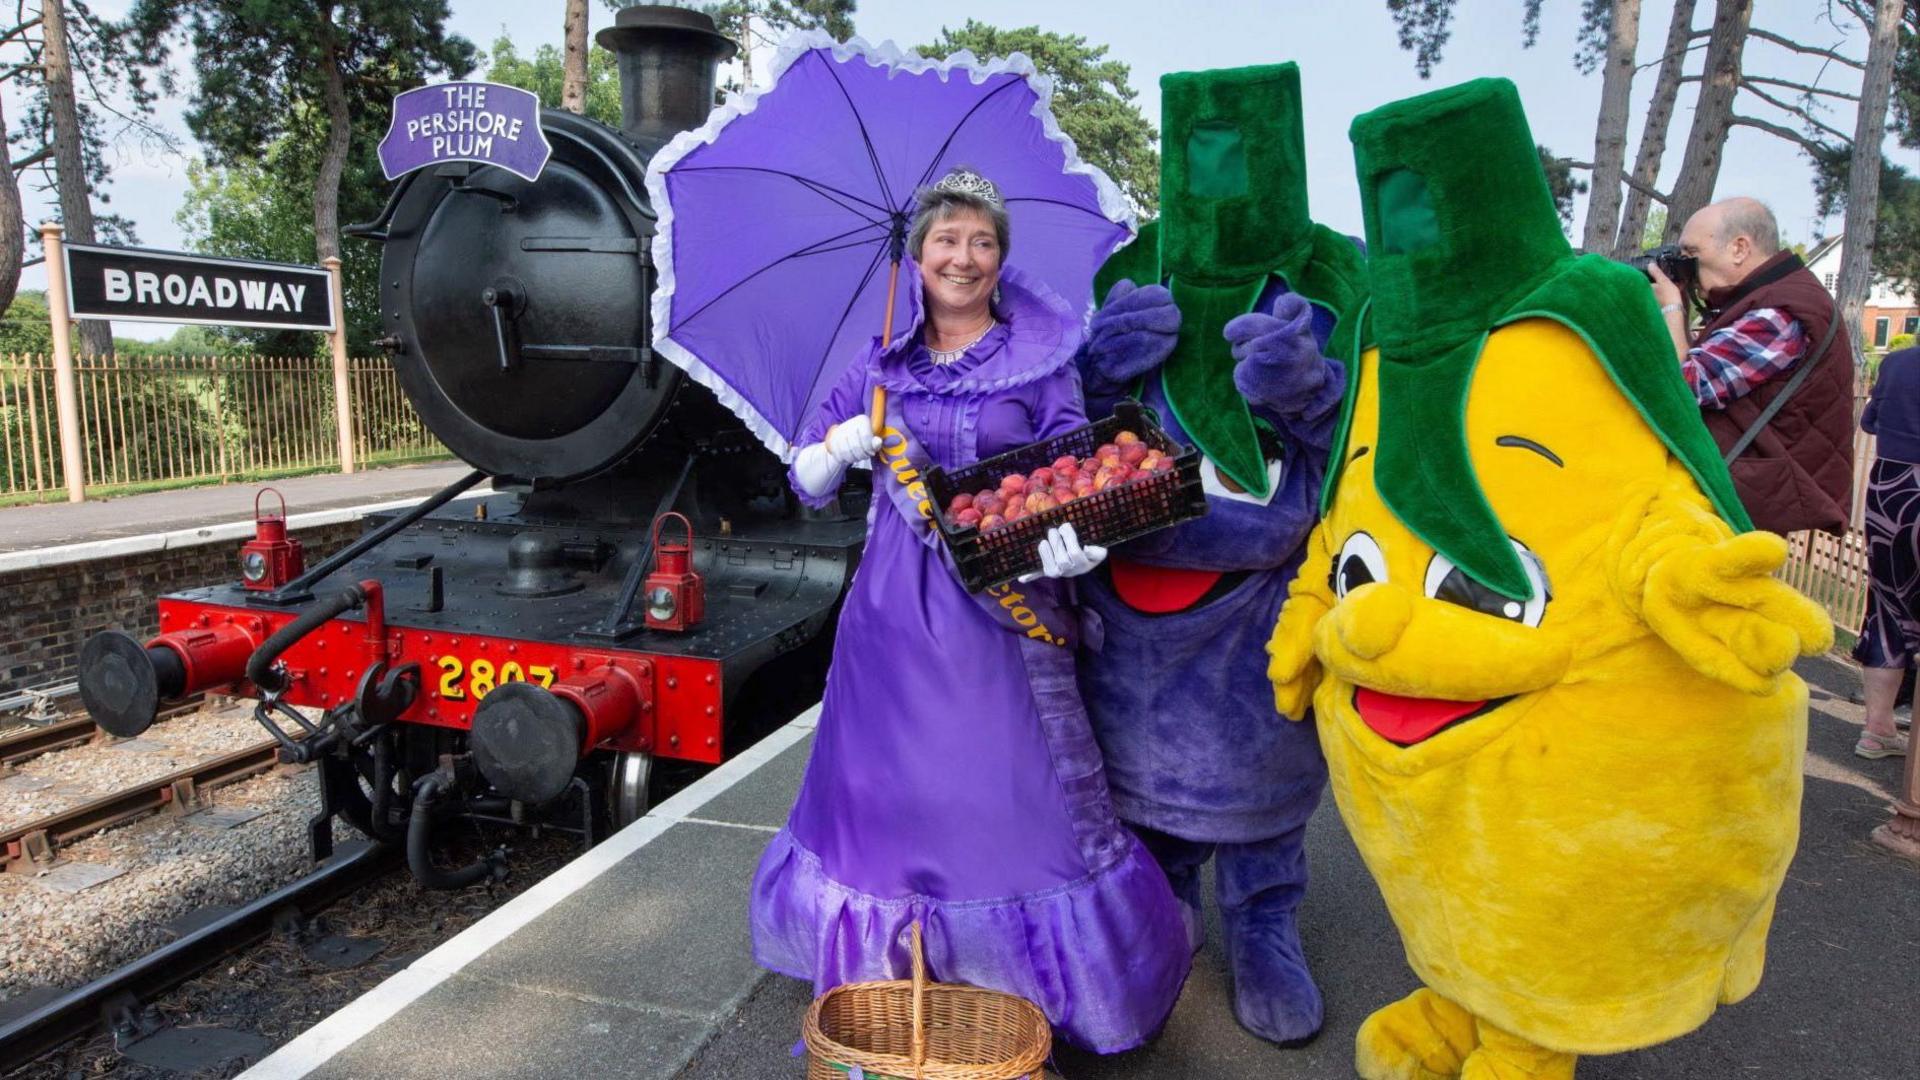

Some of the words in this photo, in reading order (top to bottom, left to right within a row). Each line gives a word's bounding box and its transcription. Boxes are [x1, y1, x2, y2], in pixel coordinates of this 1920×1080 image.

[443, 86, 487, 109] THE
[406, 112, 523, 142] PERSHORE
[433, 134, 493, 158] PLUM
[103, 268, 306, 313] BROADWAY
[879, 426, 941, 537] Quee
